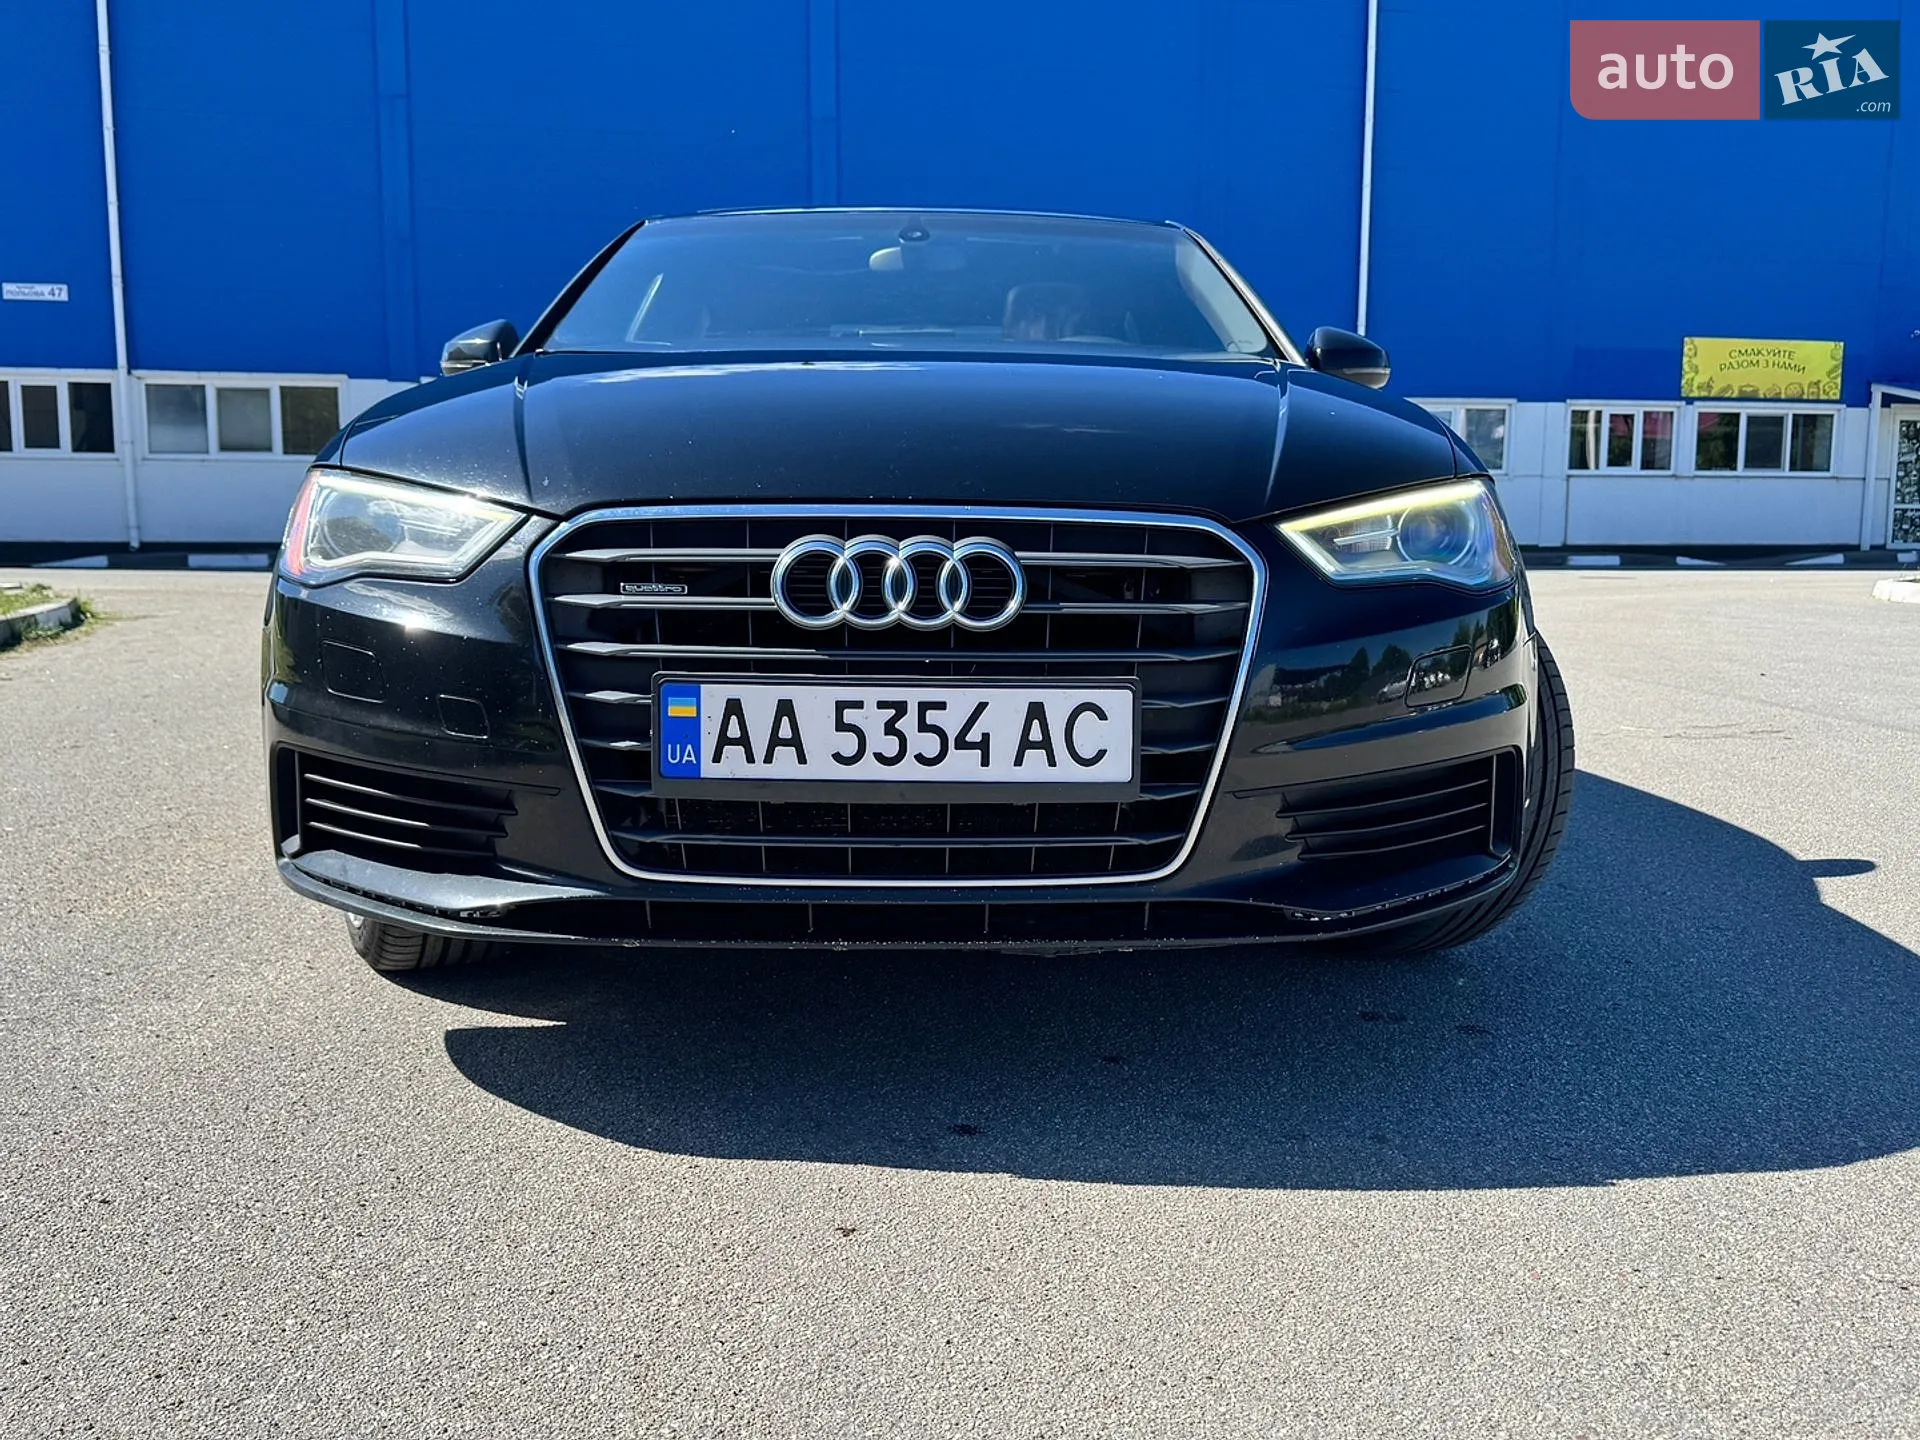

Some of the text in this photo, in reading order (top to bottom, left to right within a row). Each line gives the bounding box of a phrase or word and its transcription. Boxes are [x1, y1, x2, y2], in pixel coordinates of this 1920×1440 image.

[48, 286, 63, 298] 47
[1728, 347, 1797, 360] СМАКУЙТЕ
[1719, 359, 1760, 373] РАЗОМ
[1771, 360, 1806, 375] НАМИ
[625, 584, 682, 593] quattro
[711, 697, 1109, 769] AA 5354 AC
[667, 744, 697, 765] UA
